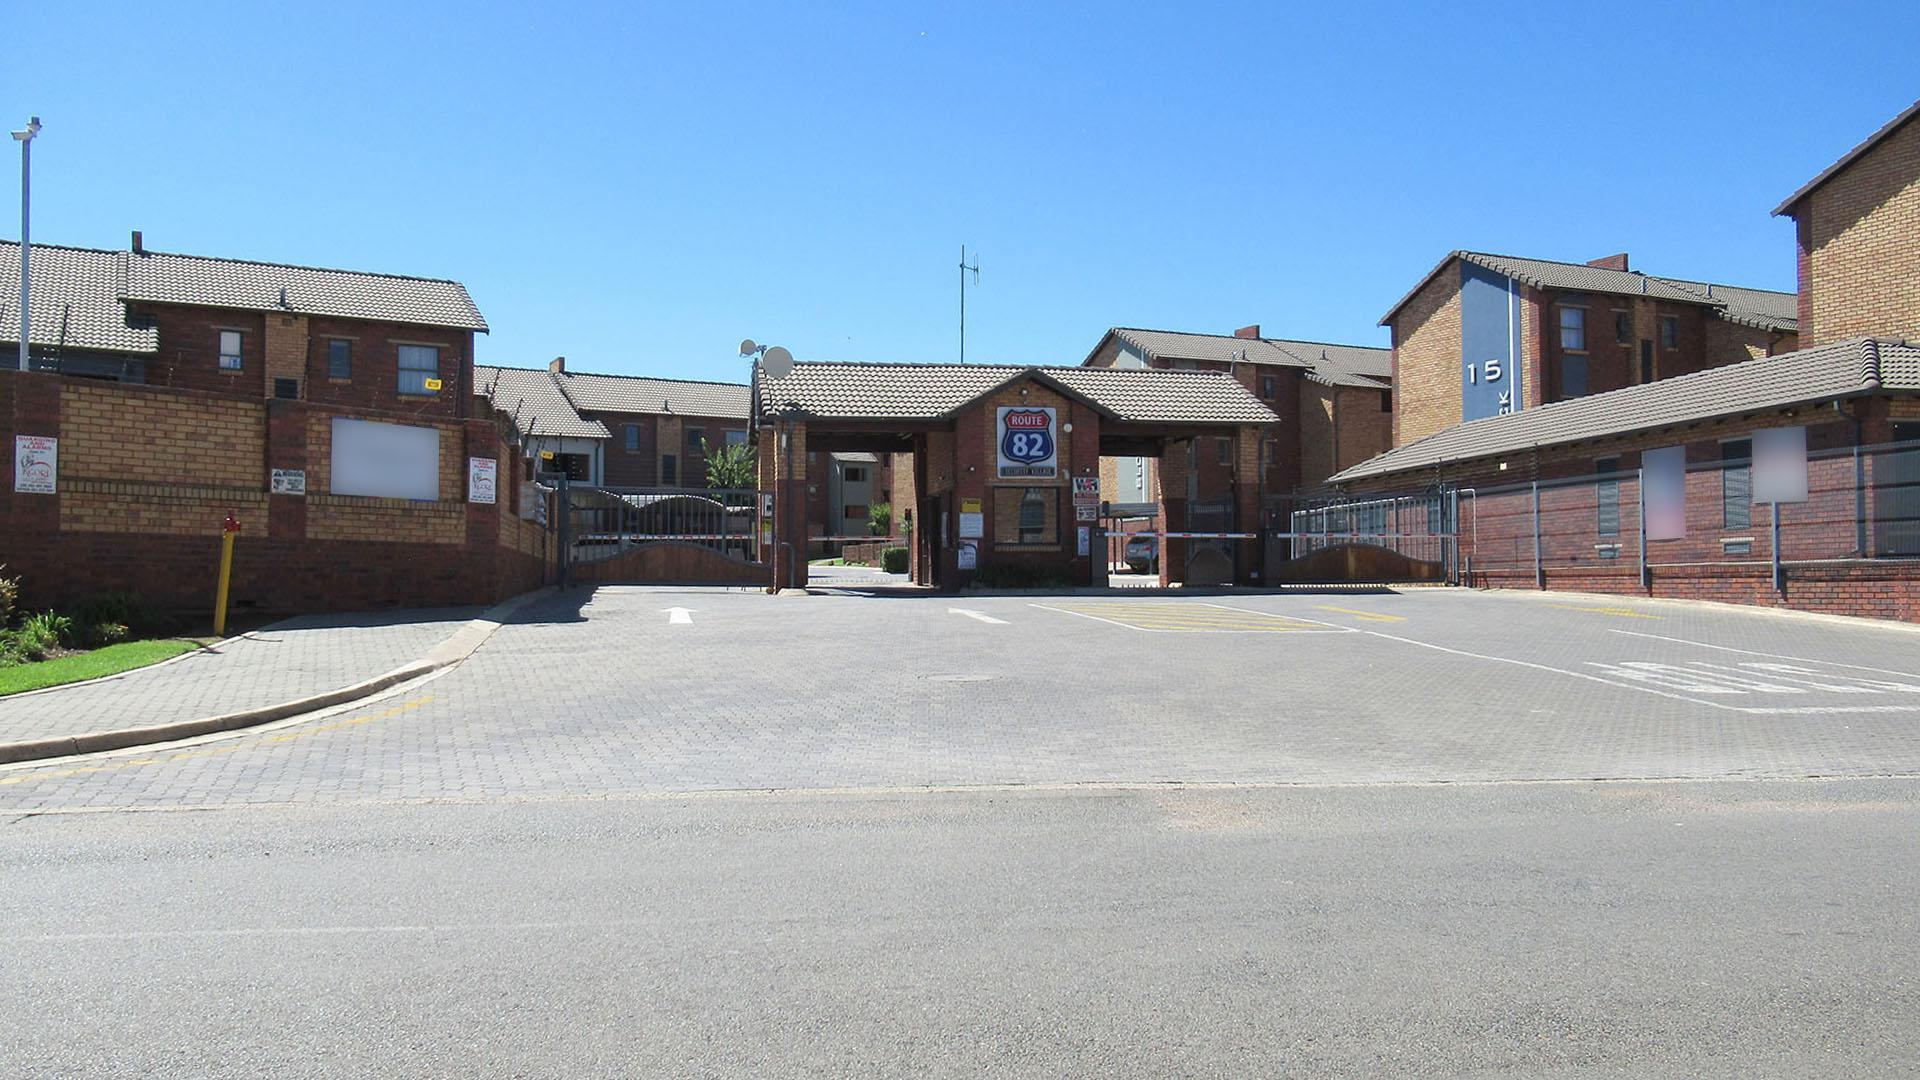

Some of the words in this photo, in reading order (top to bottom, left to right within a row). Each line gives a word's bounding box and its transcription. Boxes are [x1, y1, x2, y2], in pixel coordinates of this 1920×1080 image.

[1467, 359, 1502, 384] 15
[1011, 415, 1043, 426] ROUTE
[1012, 432, 1044, 457] 82
